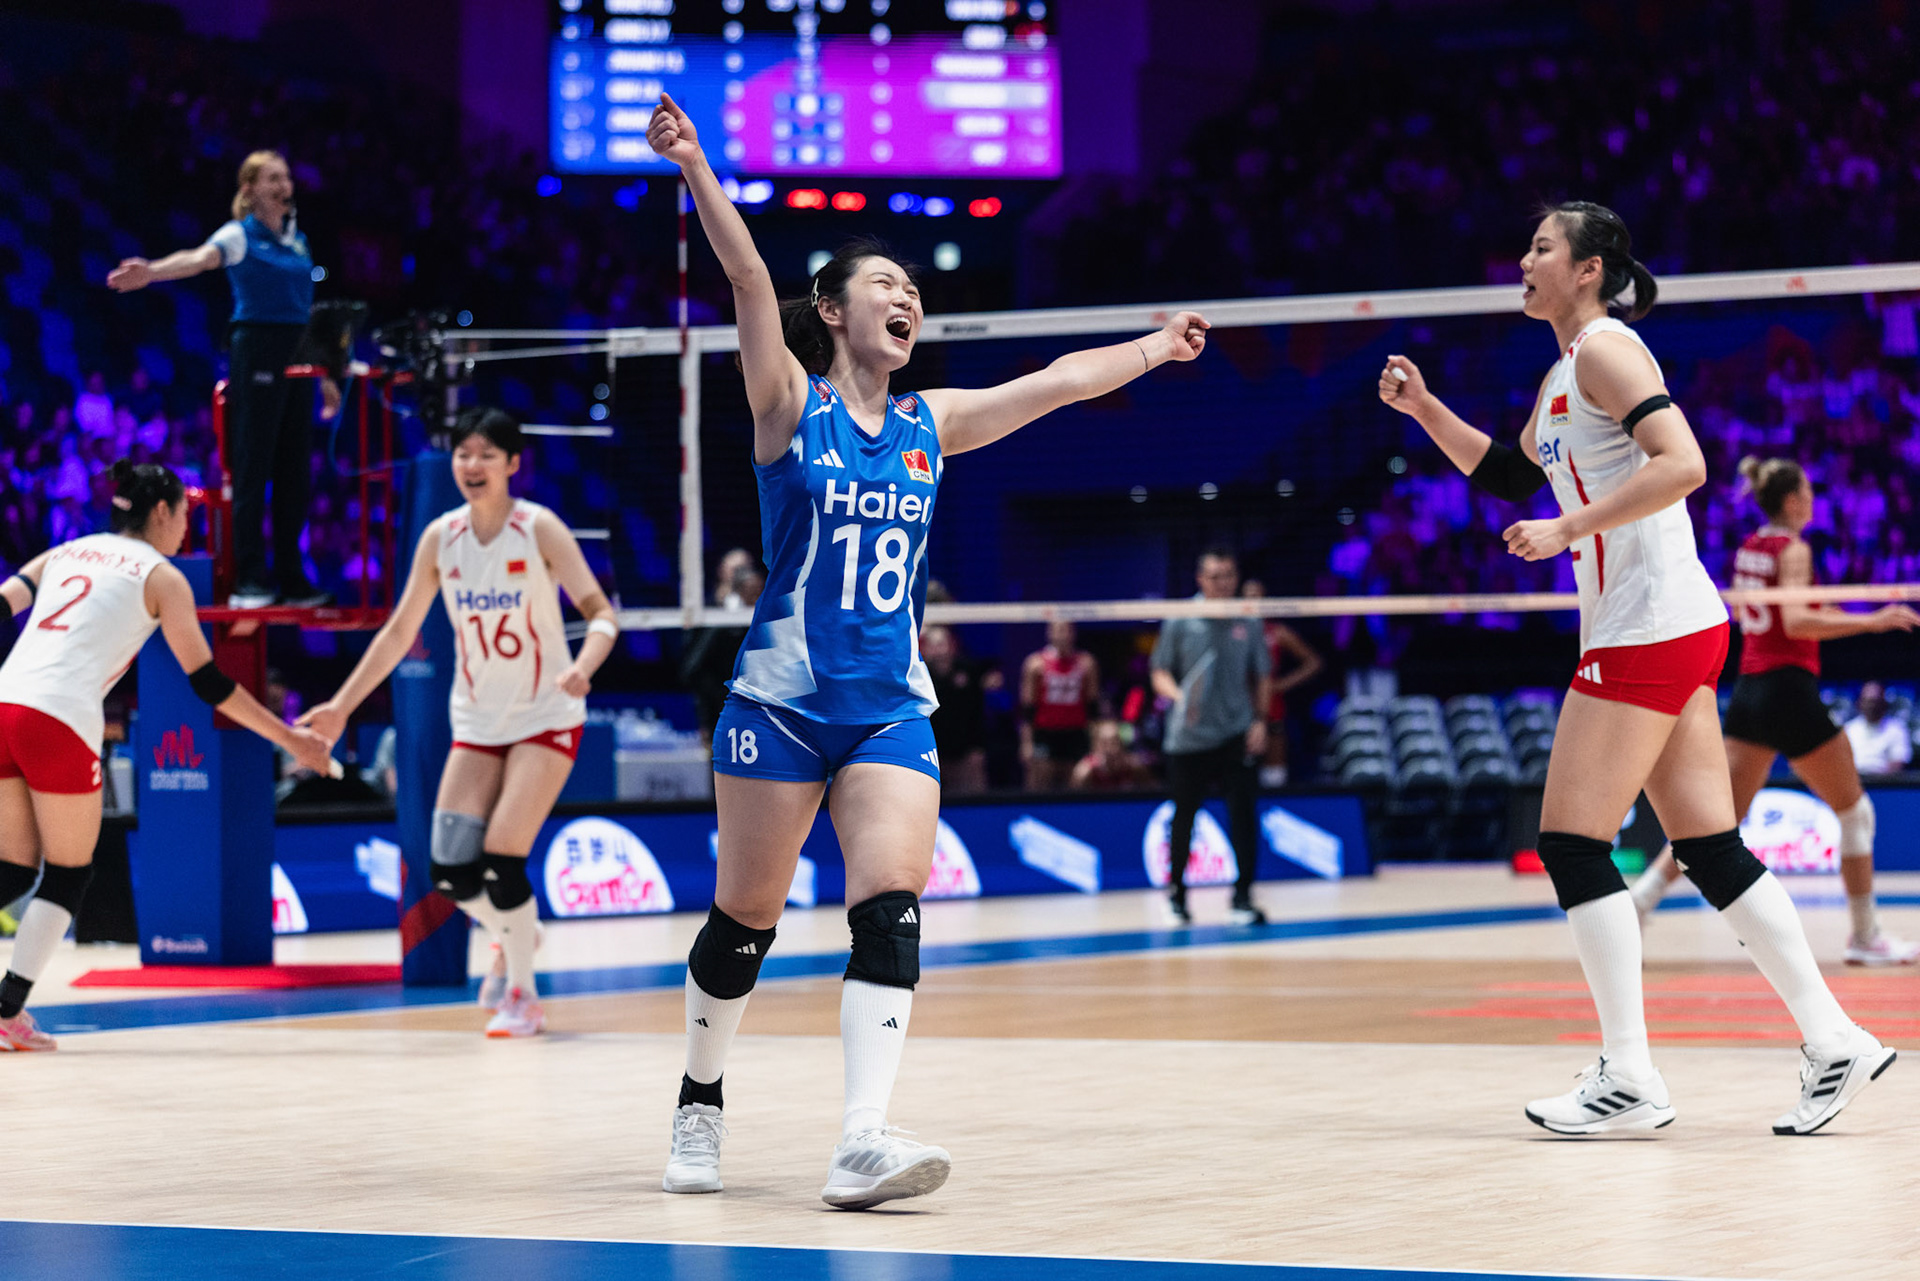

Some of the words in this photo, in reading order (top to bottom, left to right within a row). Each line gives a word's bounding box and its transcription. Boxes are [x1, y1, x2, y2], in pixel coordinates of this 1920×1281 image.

[913, 470, 931, 481] CHN
[823, 478, 931, 524] Haier
[832, 523, 910, 613] 18
[37, 574, 93, 631] 2
[455, 587, 522, 611] Haier
[468, 614, 522, 660] 16
[728, 727, 759, 765] 18
